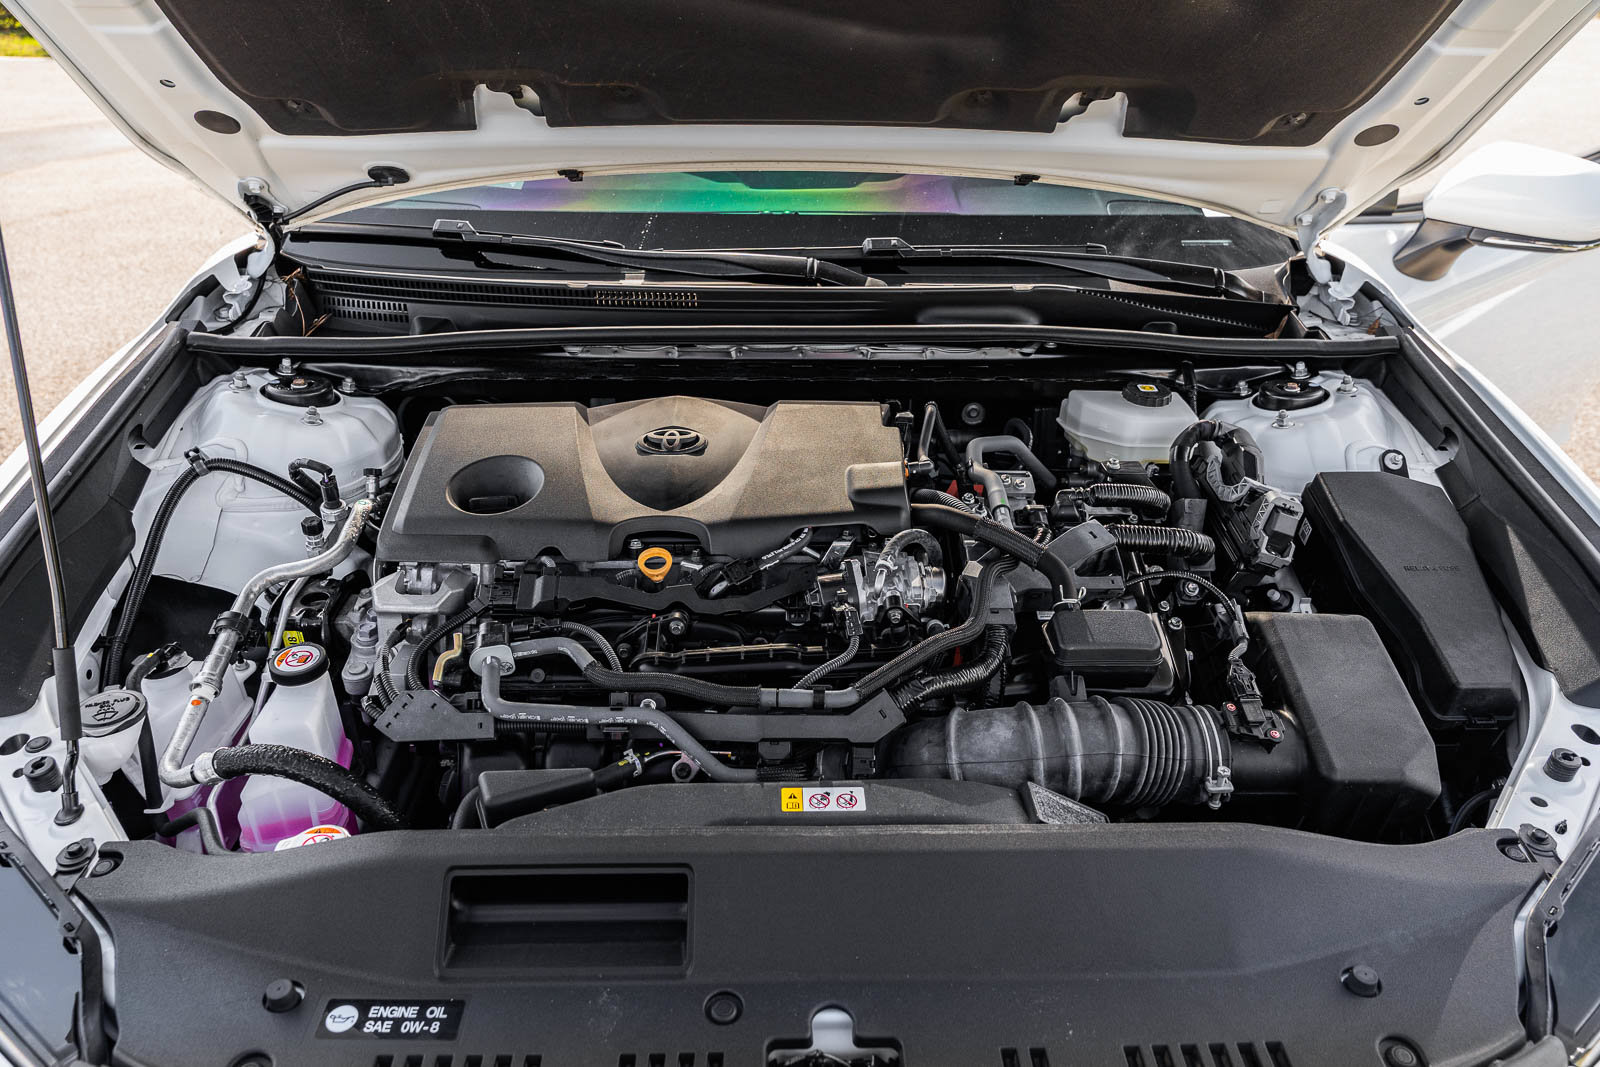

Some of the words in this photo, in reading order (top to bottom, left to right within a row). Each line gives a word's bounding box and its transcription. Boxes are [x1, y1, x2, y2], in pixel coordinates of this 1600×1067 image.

[368, 1006, 419, 1018] ENGINE
[425, 1006, 448, 1018] OIL
[363, 1020, 394, 1033] SAE
[400, 1021, 440, 1033] 0W-8
